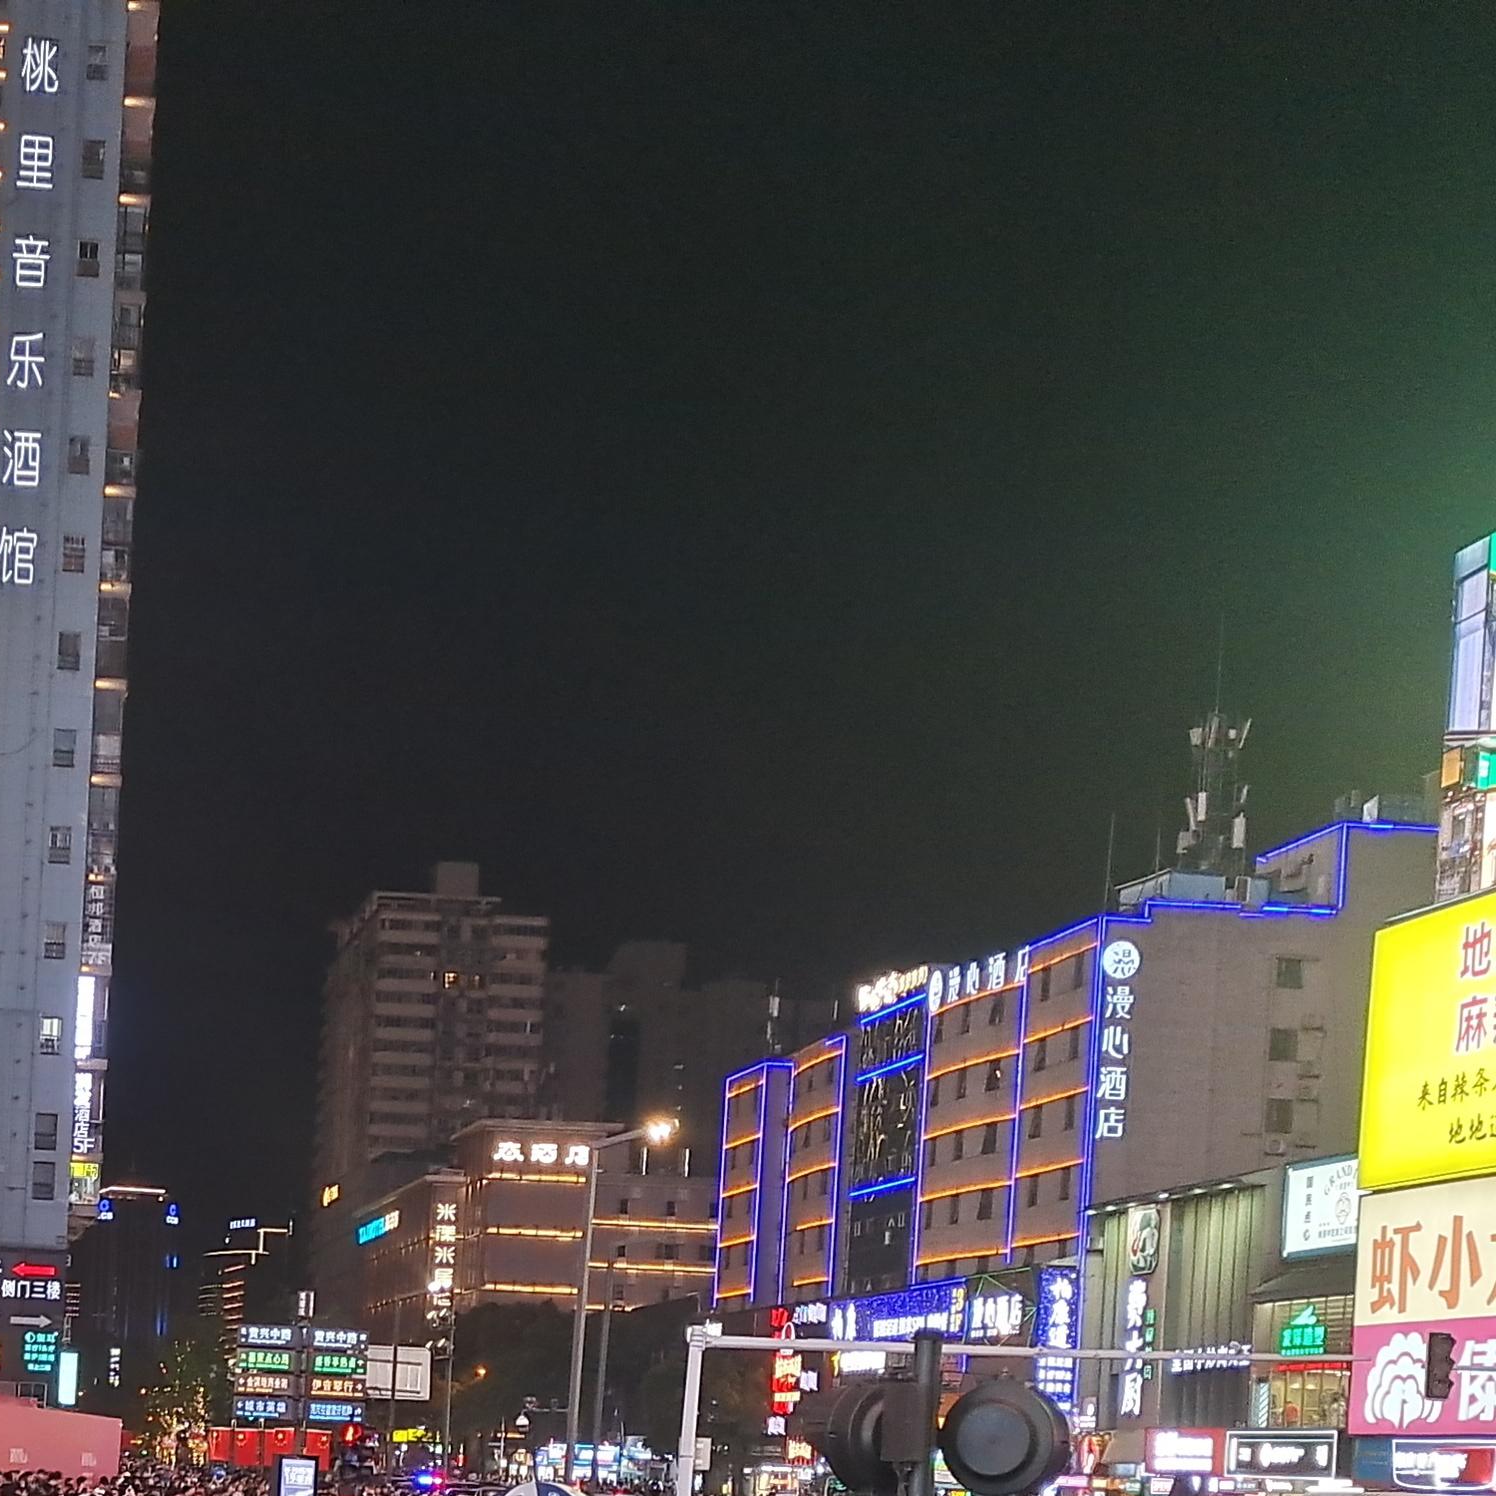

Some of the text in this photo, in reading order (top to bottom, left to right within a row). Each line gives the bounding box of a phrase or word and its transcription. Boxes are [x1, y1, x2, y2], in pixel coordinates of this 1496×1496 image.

[947, 945, 1030, 1003] 漫心酒店
[1456, 995, 1496, 1053] 麻
[1096, 985, 1135, 1141] 漫心酒店
[1417, 1067, 1496, 1111] 来自辣条
[1, 1279, 61, 1300] 侧门三楼
